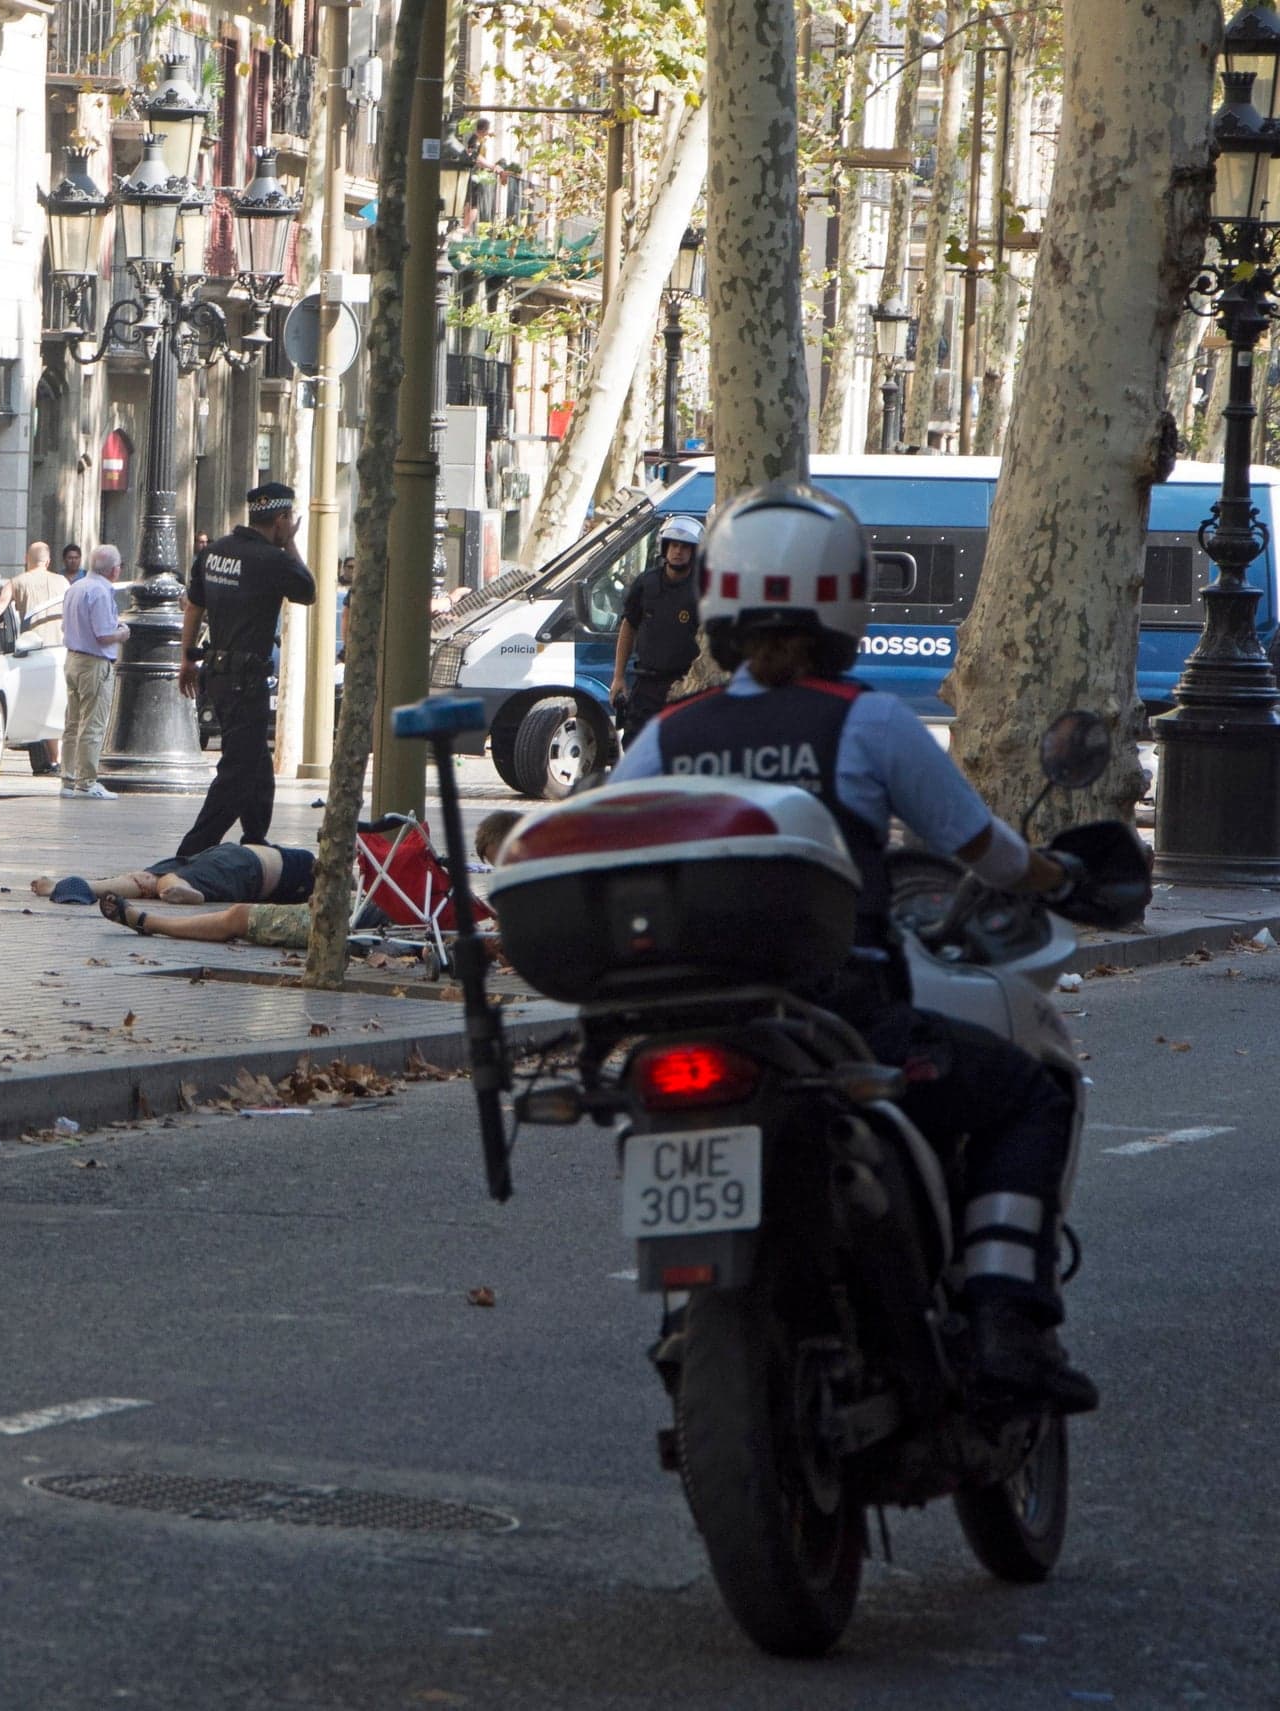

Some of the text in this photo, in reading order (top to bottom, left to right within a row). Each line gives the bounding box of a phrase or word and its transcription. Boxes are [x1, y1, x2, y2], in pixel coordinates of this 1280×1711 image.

[206, 553, 241, 576] POLICIA
[500, 644, 536, 656] policia
[672, 742, 820, 779] POLICIA
[654, 1137, 730, 1182] CME
[641, 1180, 745, 1227] 3059
